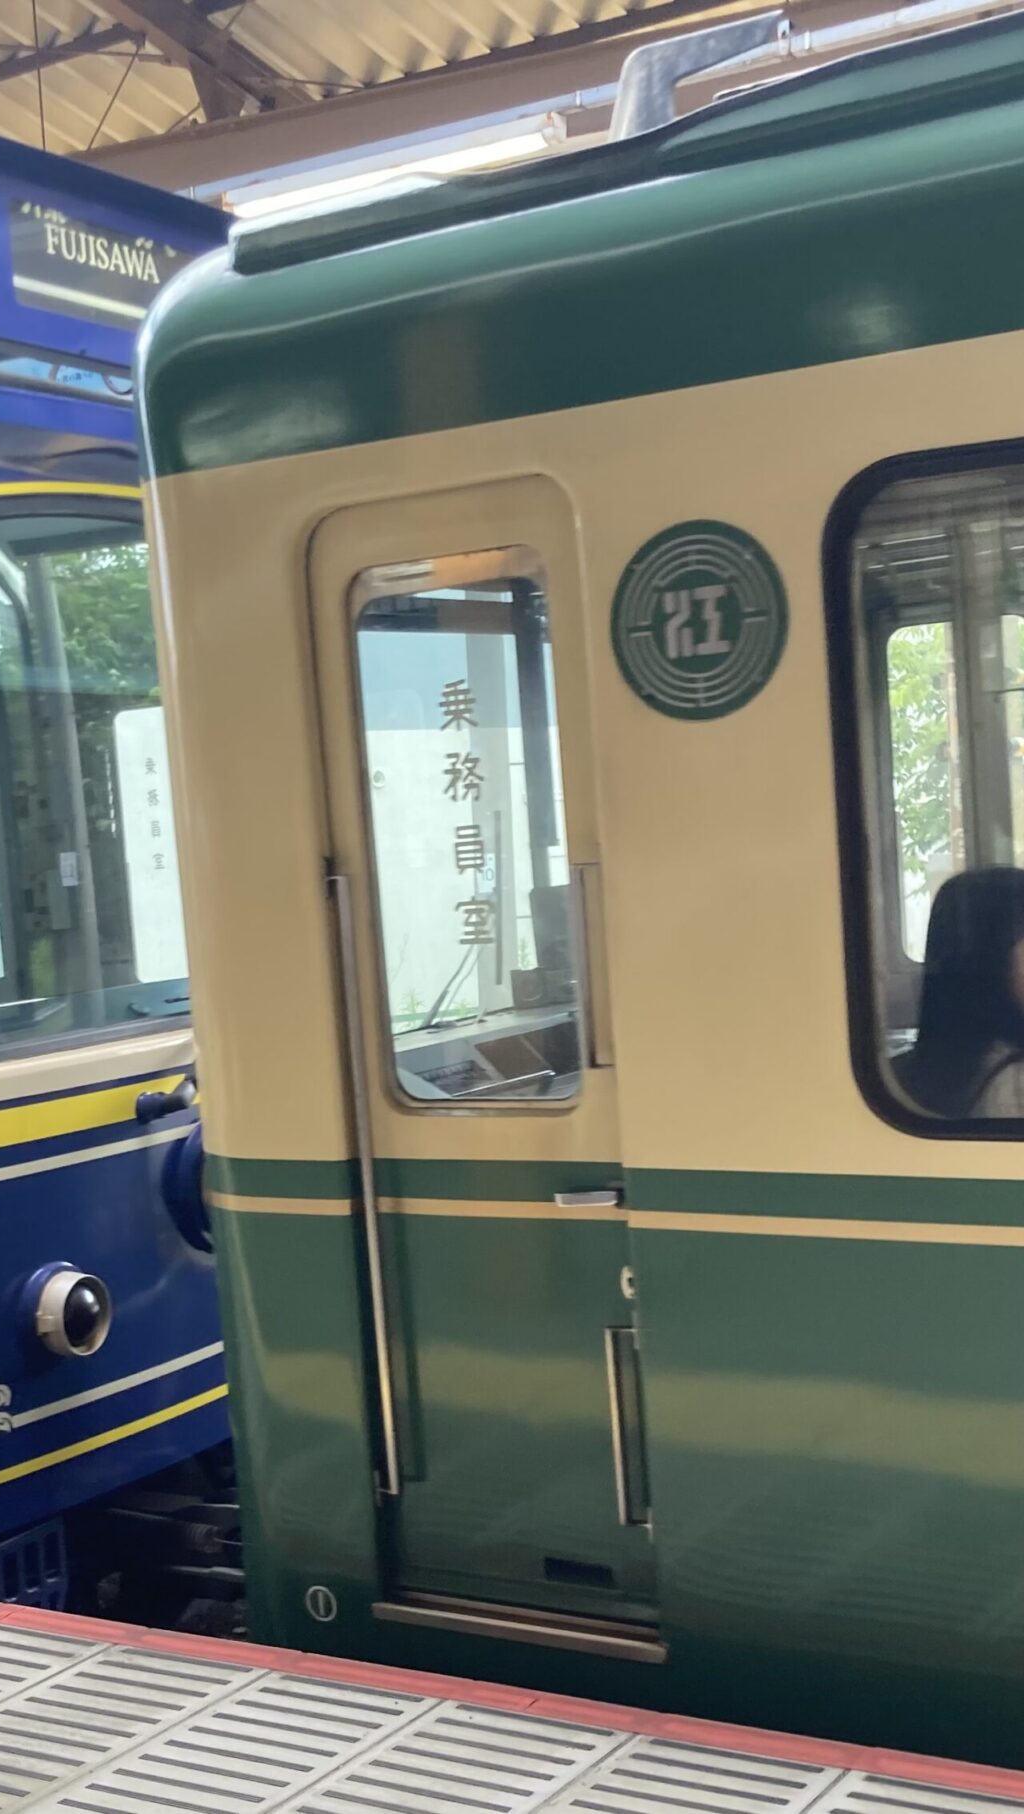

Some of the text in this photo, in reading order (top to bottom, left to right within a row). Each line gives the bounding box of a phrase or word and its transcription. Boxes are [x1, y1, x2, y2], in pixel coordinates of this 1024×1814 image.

[44, 223, 160, 284] FUJISAWA
[439, 678, 496, 945] 乗務員室
